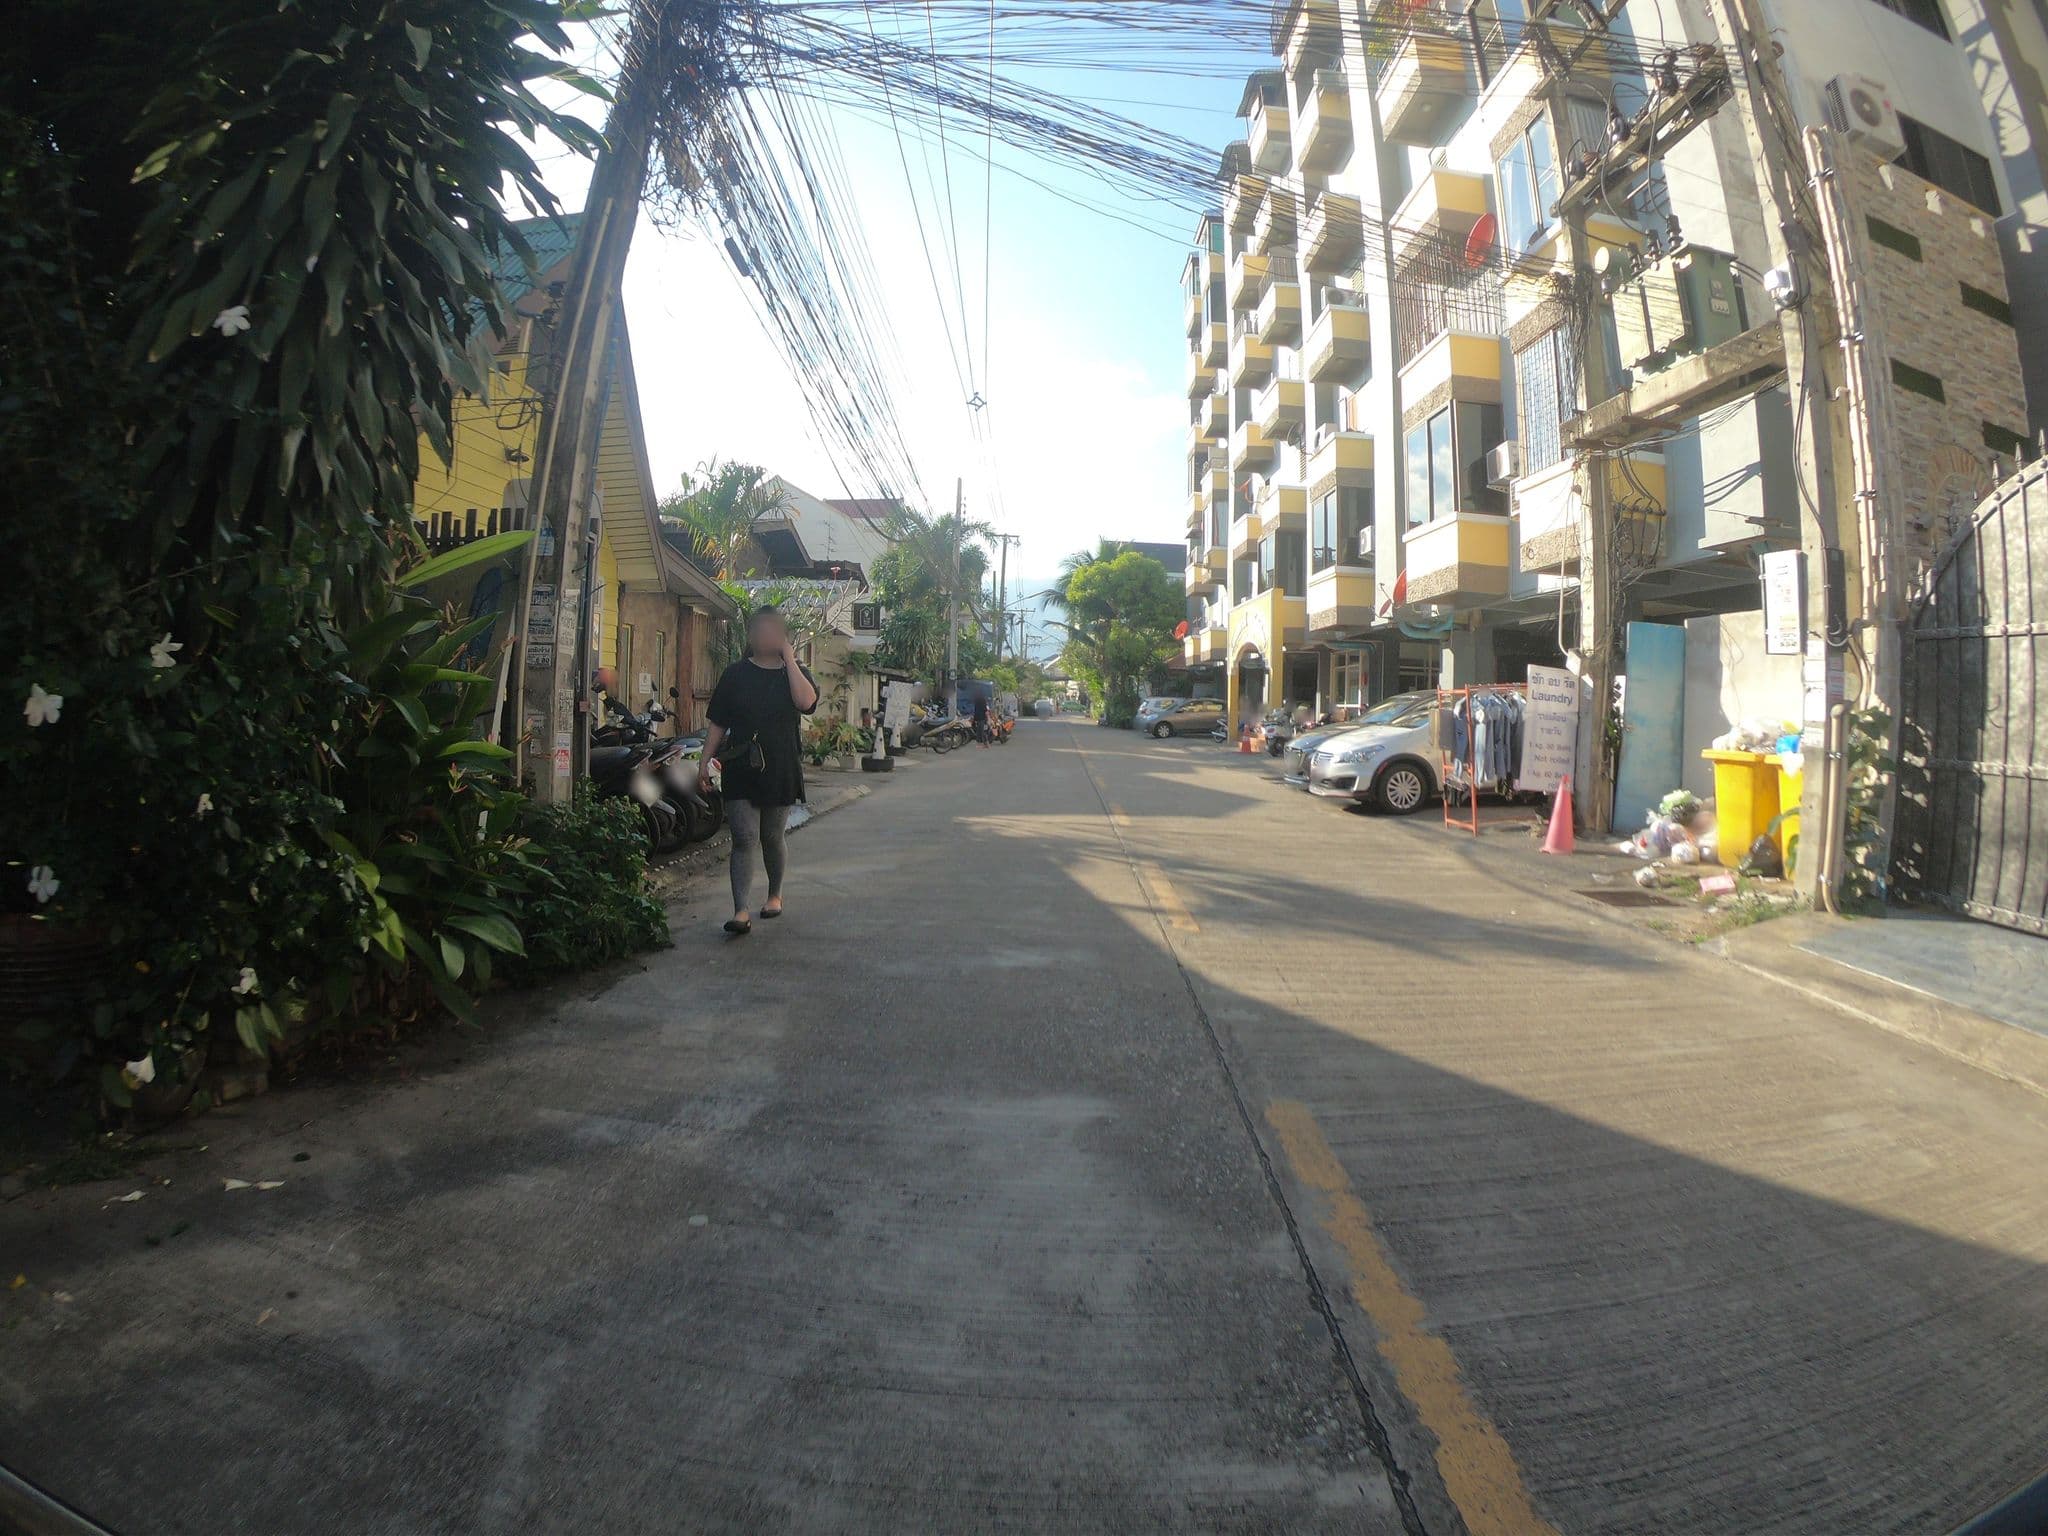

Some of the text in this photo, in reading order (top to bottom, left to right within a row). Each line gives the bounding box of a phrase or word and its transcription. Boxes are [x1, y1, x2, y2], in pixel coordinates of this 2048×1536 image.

[1531, 672, 1576, 689] ซัก อบ รีด
[1531, 689, 1573, 705] Laundry
